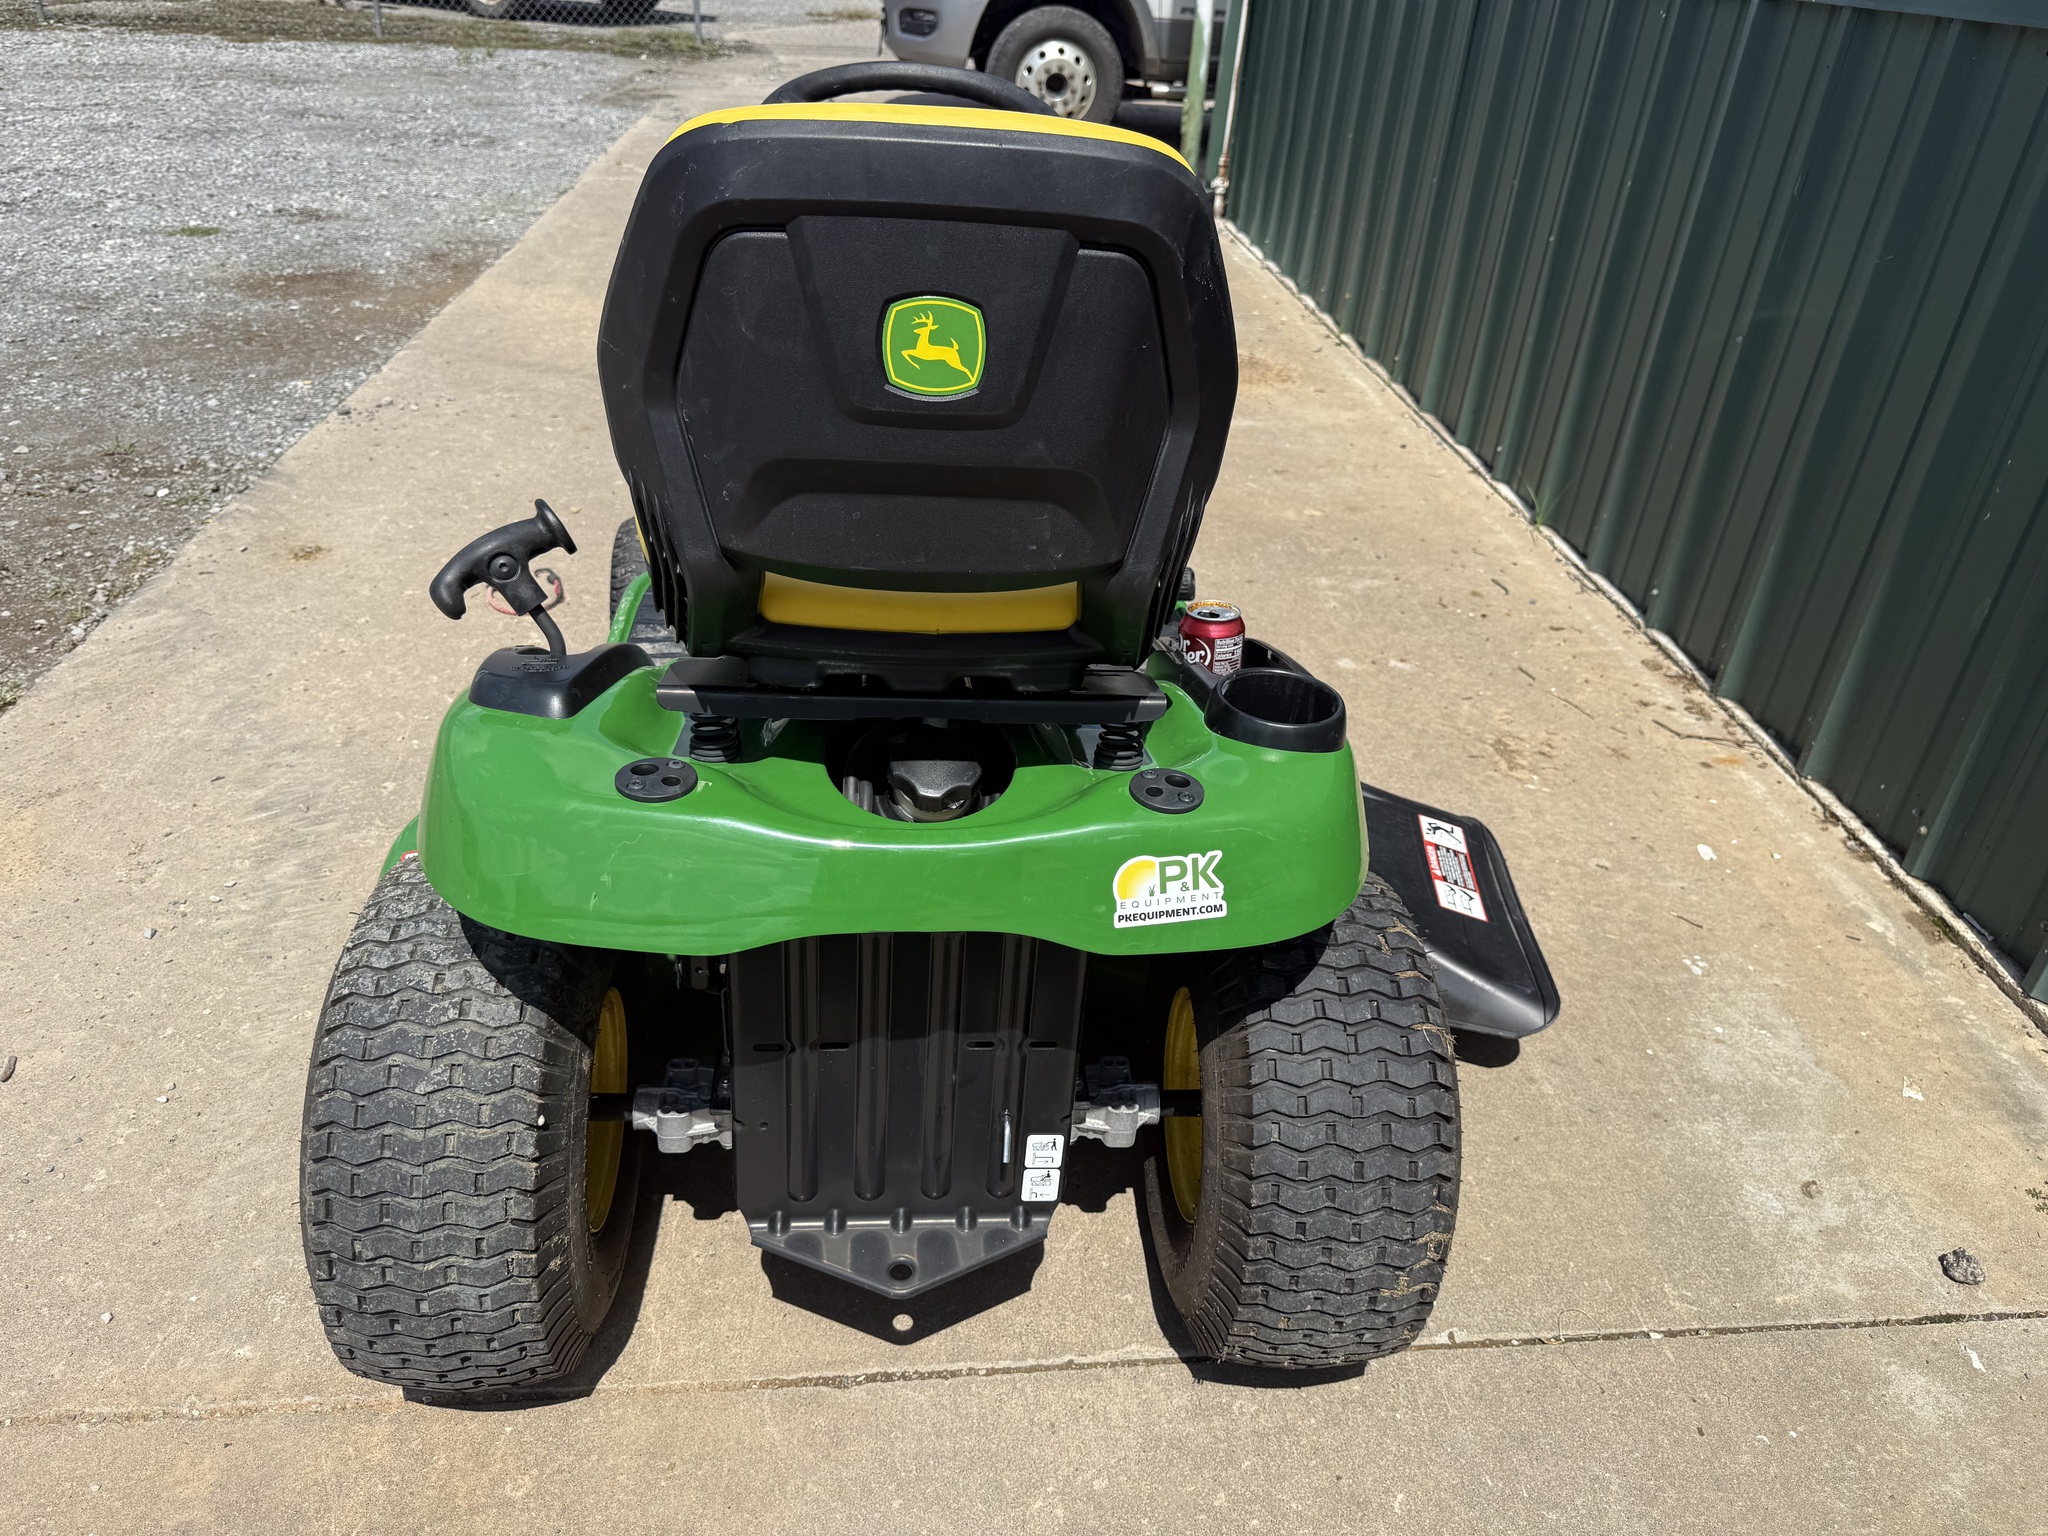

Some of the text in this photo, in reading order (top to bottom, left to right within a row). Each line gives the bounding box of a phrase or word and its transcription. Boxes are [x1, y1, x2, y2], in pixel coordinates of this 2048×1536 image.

[1158, 854, 1219, 894] P&K
[1120, 891, 1221, 910] EQUIPMENT
[1118, 904, 1223, 923] PKEQUIPMENT.COM
